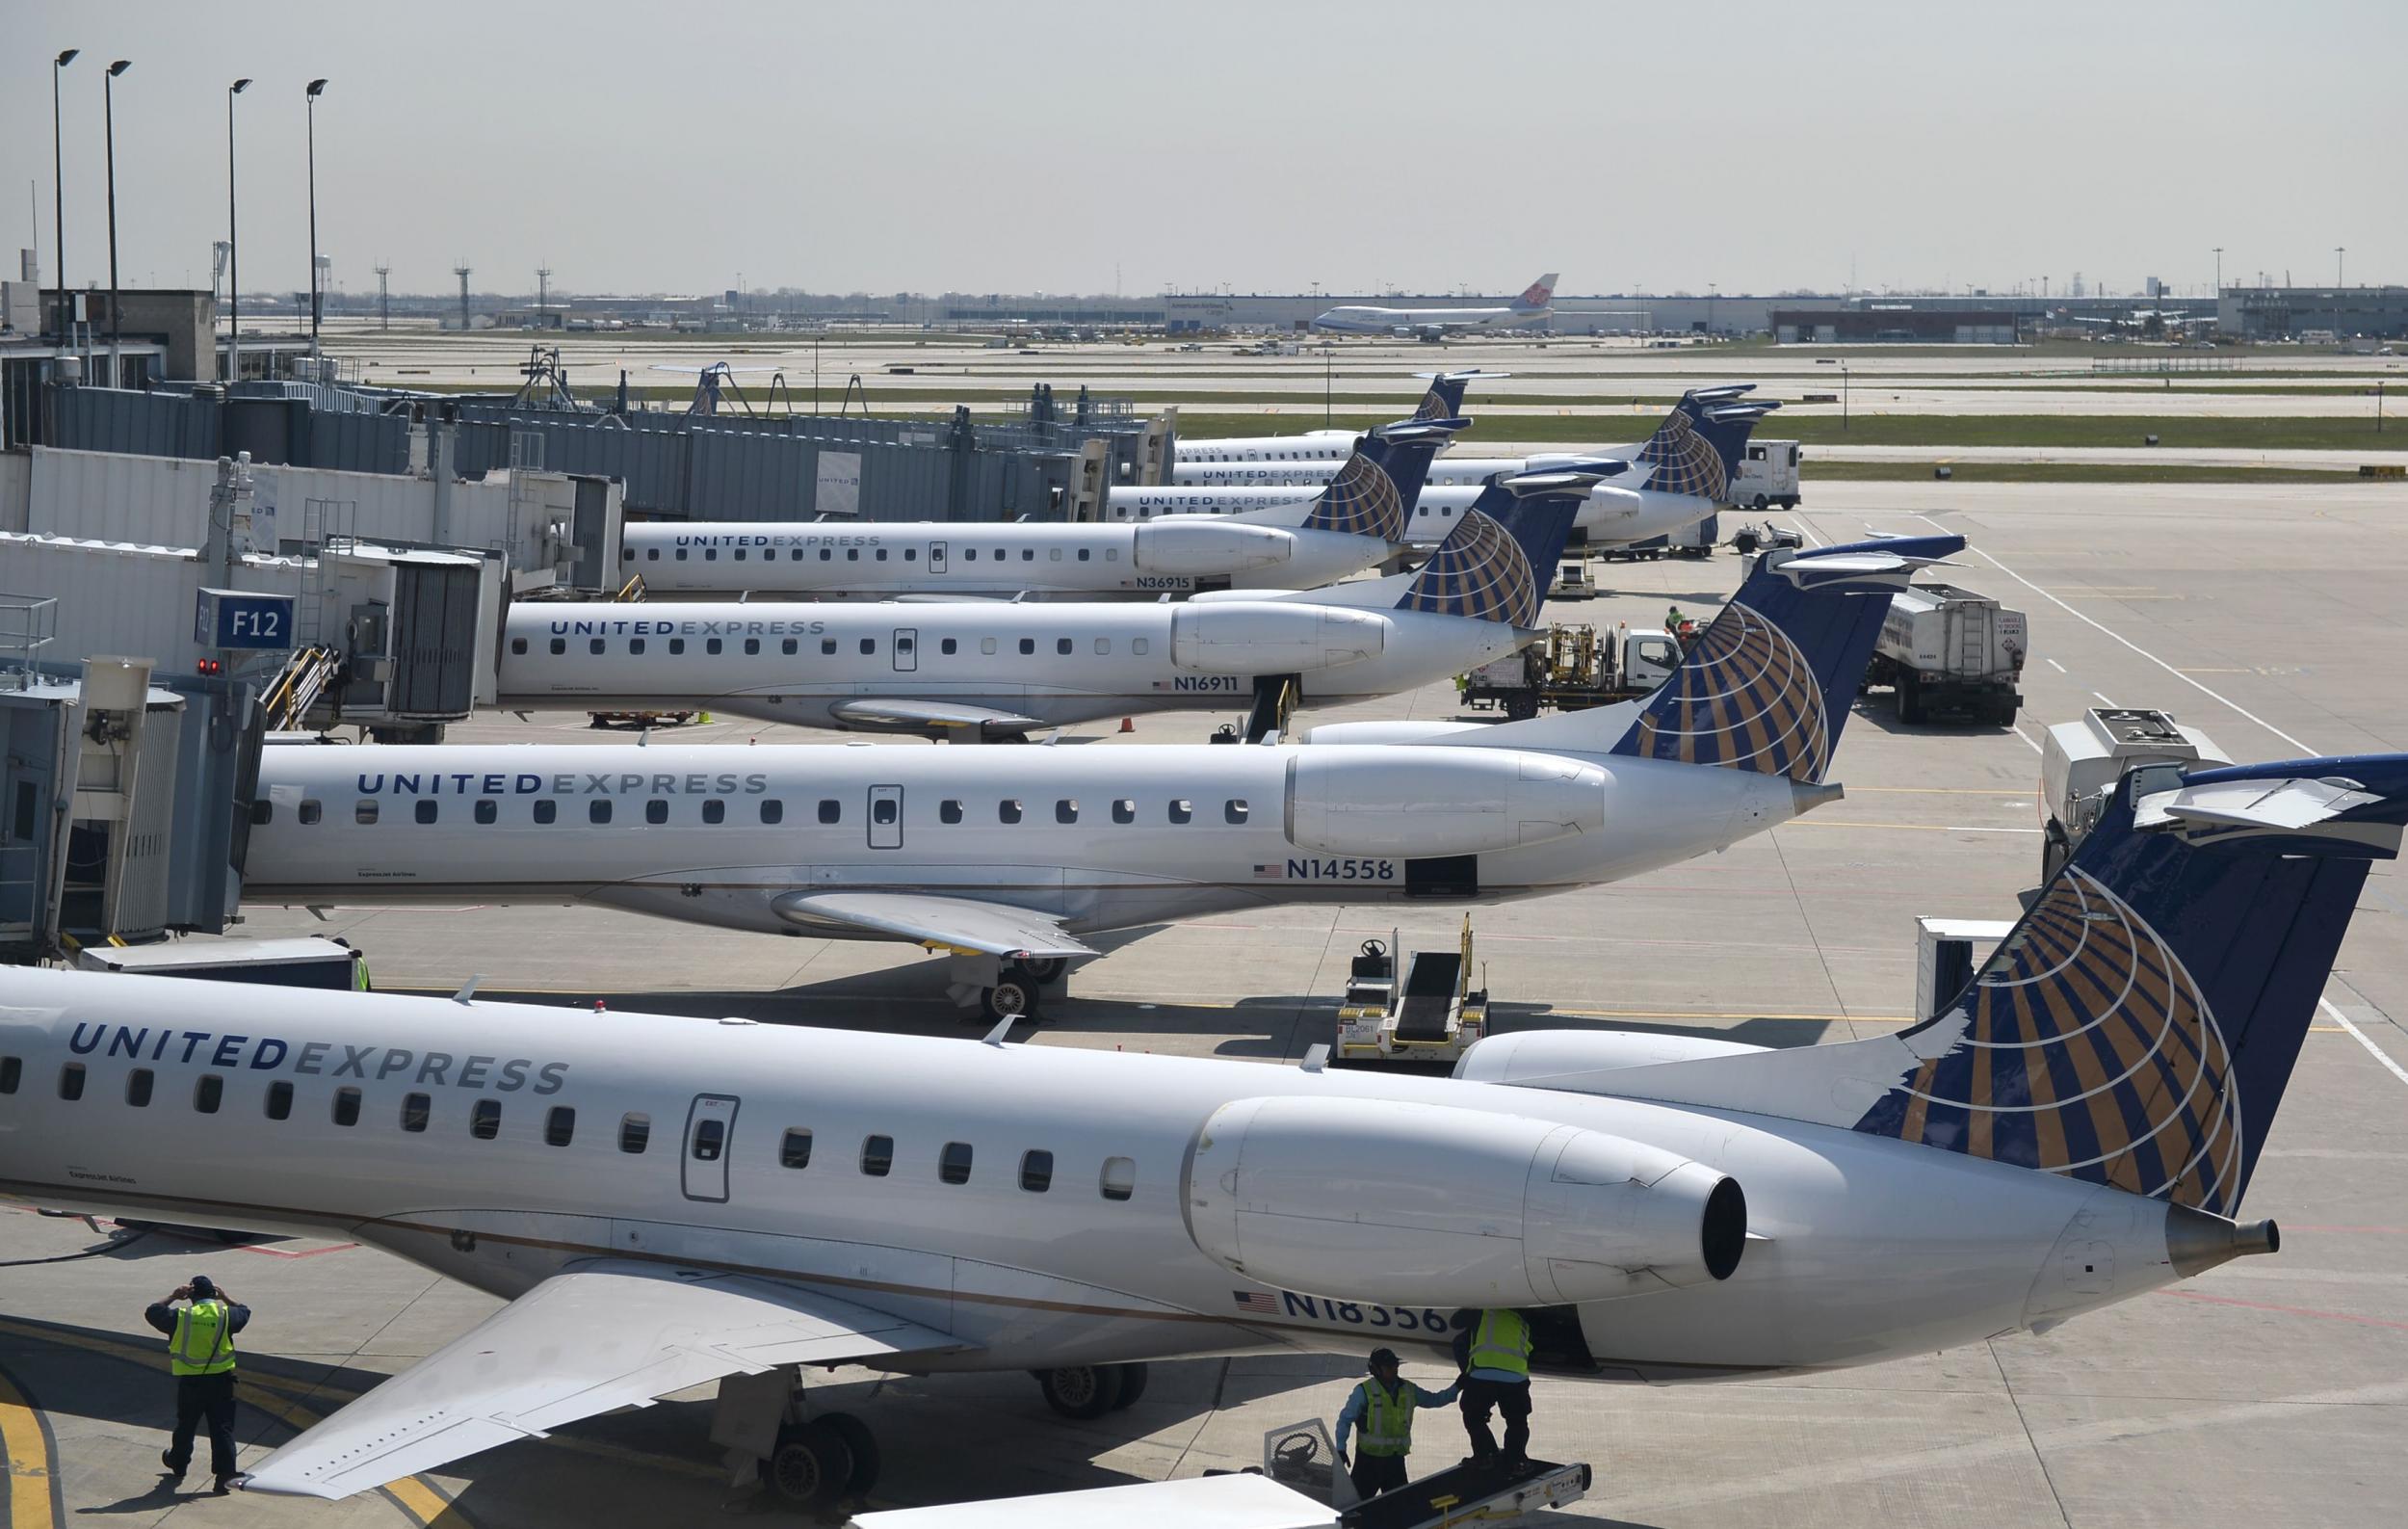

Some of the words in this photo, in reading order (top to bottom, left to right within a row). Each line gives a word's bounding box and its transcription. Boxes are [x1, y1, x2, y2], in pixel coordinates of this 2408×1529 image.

[1176, 447, 1222, 456] XPRESS
[1203, 469, 1337, 479] UNITEDEXPRES
[1137, 577, 1190, 588] N36915
[232, 611, 278, 637] F12
[1174, 676, 1238, 691] N16911
[1287, 858, 1394, 880] N14558
